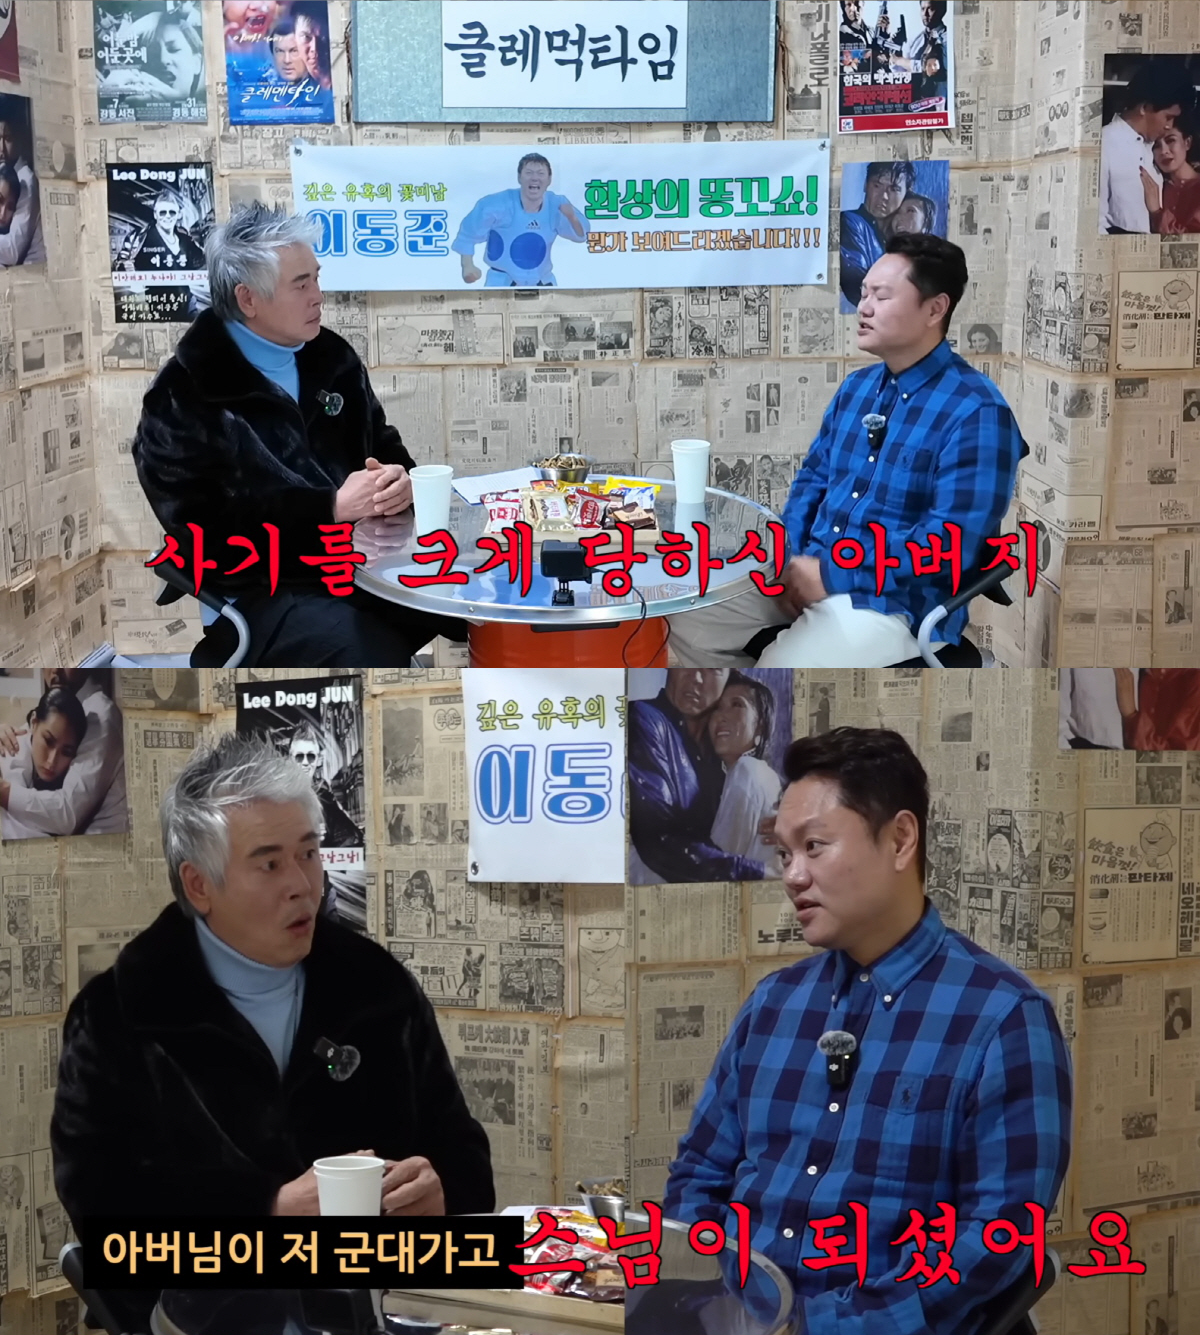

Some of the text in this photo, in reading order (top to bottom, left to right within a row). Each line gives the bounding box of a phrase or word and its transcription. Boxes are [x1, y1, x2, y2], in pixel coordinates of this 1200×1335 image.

[444, 20, 678, 85] 클레먹타임
[240, 78, 320, 107] 클레멘타인
[843, 73, 871, 86] 한국의
[140, 168, 176, 182] Dong
[179, 167, 207, 180] JUN
[303, 183, 447, 202] 깊은 유혹의 꽃미남
[584, 175, 818, 220] 환상의 똥꼬쇼!
[586, 231, 628, 253] 뭔가
[243, 686, 353, 709] Lee Dong JUN
[476, 699, 523, 732] 깊은
[532, 694, 605, 731] 유혹의
[474, 741, 624, 826] 이동
